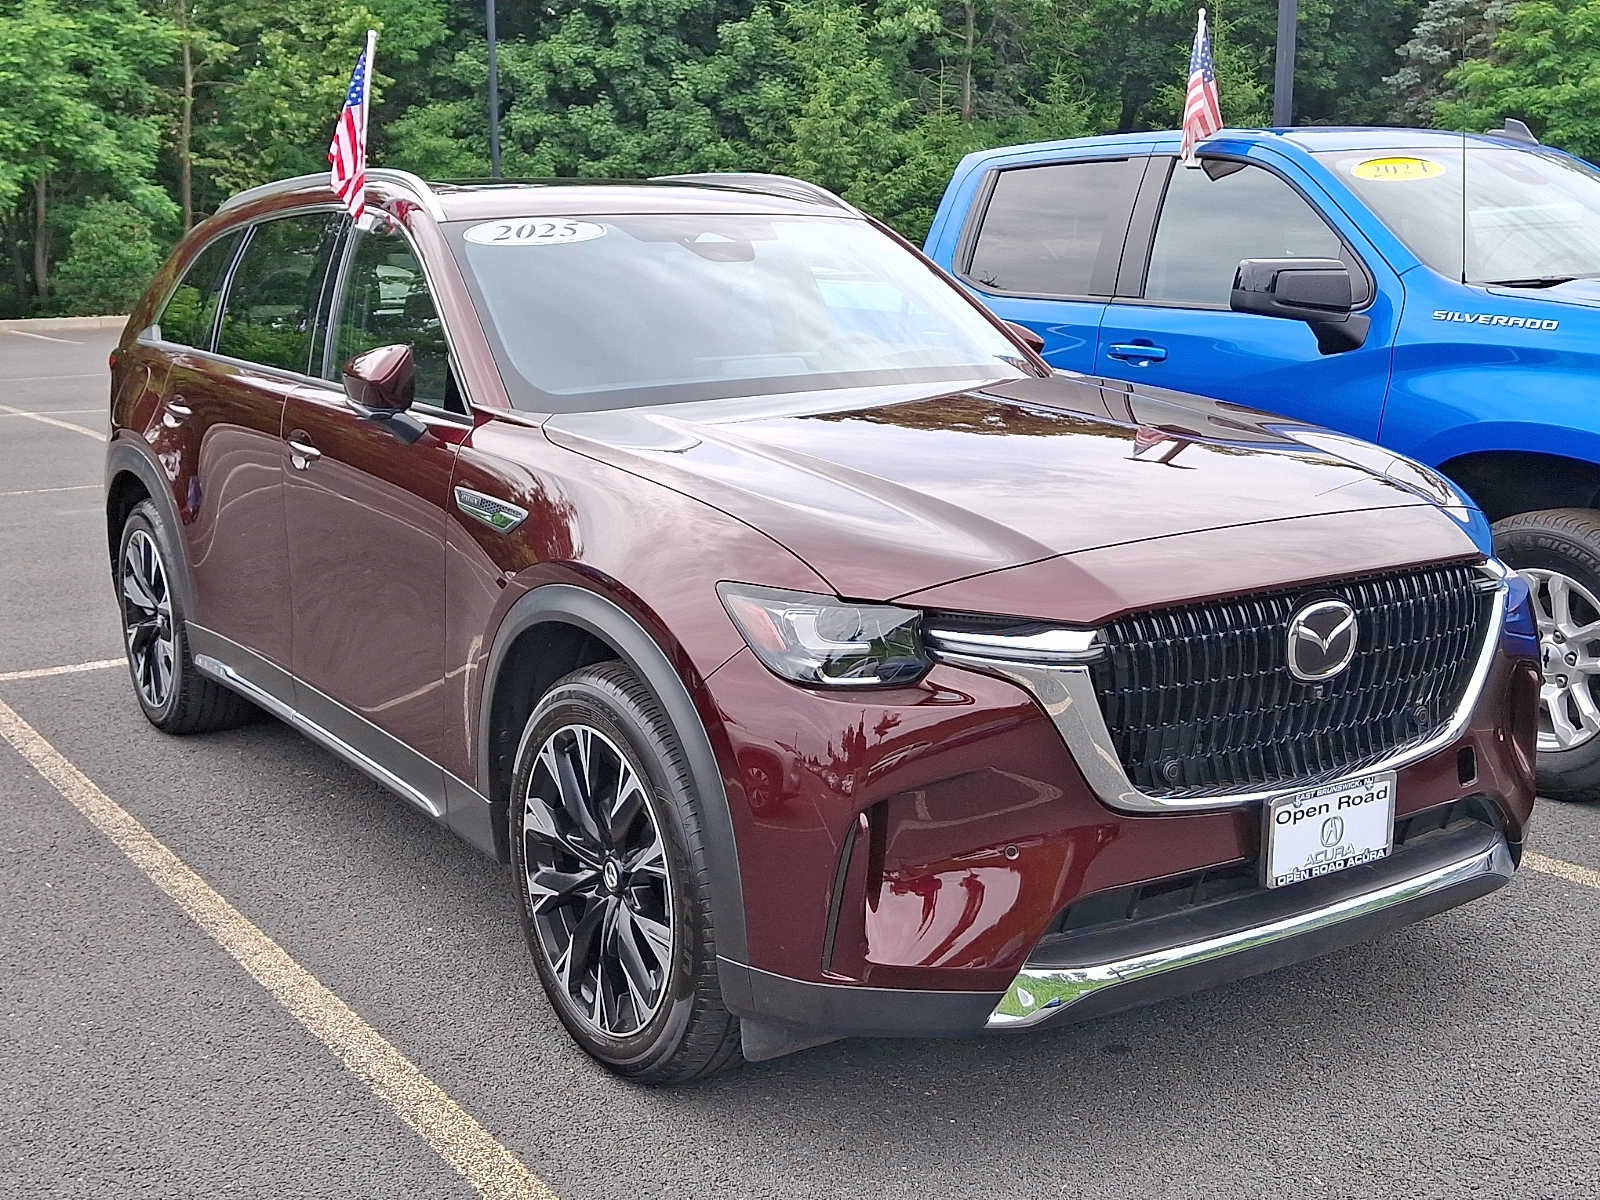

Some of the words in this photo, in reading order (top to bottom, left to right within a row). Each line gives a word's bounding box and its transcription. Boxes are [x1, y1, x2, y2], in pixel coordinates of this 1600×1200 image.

[492, 223, 579, 241] 2025
[1432, 310, 1559, 331] SILVERADO
[1276, 803, 1330, 825] Open
[1337, 786, 1388, 810] Road
[1304, 843, 1356, 867] ACURA
[1277, 869, 1310, 886] OPEN
[1312, 860, 1345, 877] ROAD
[1346, 849, 1386, 868] ACURA
